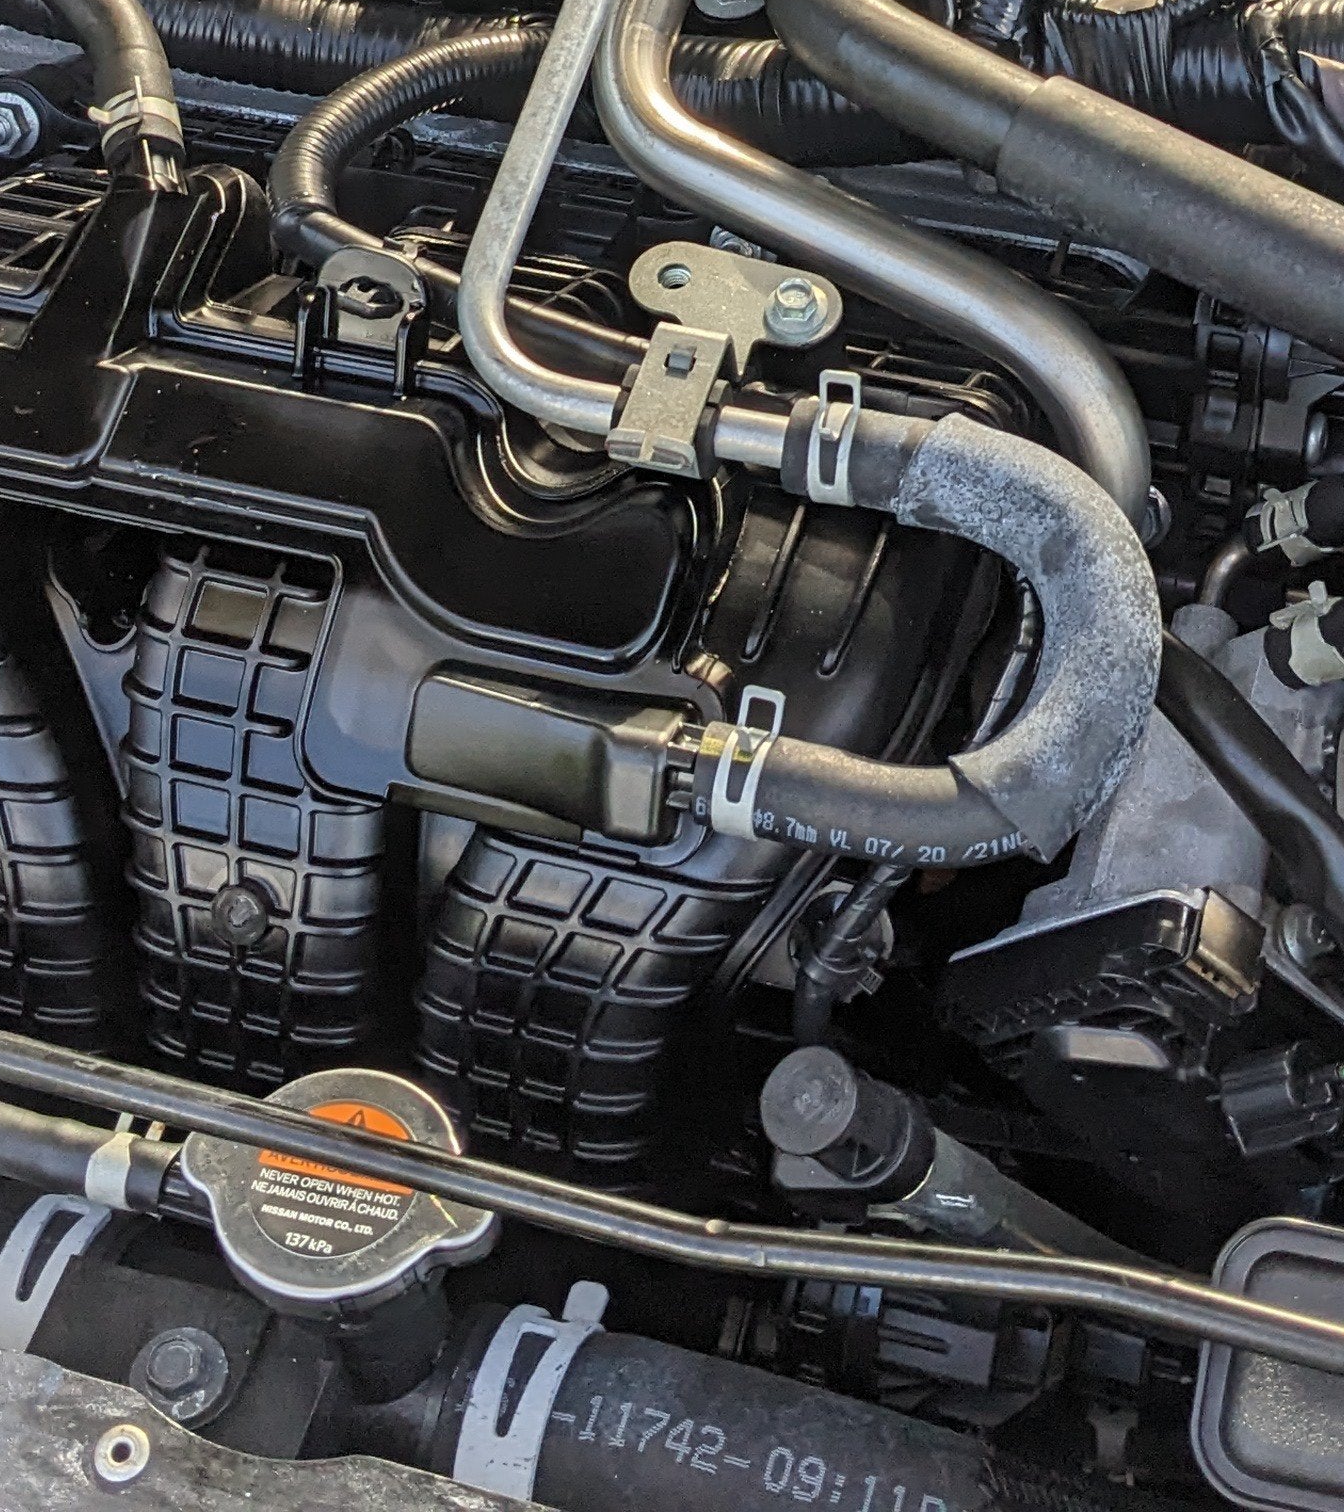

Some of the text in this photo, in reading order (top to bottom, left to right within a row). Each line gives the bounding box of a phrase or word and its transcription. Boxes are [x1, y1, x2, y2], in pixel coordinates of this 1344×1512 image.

[829, 828, 852, 850] VL
[918, 845, 946, 863] 20
[251, 1180, 269, 1193] NE
[265, 1184, 307, 1202] JAMAIS
[306, 1193, 350, 1211] OUVRIR
[356, 1202, 399, 1221] CHAUD.
[259, 1168, 402, 1207] NEVER OPEN WHEN HOT.
[260, 1204, 299, 1220] NISSAN
[297, 1211, 335, 1228] MOTOR
[353, 1224, 375, 1236] LTD.
